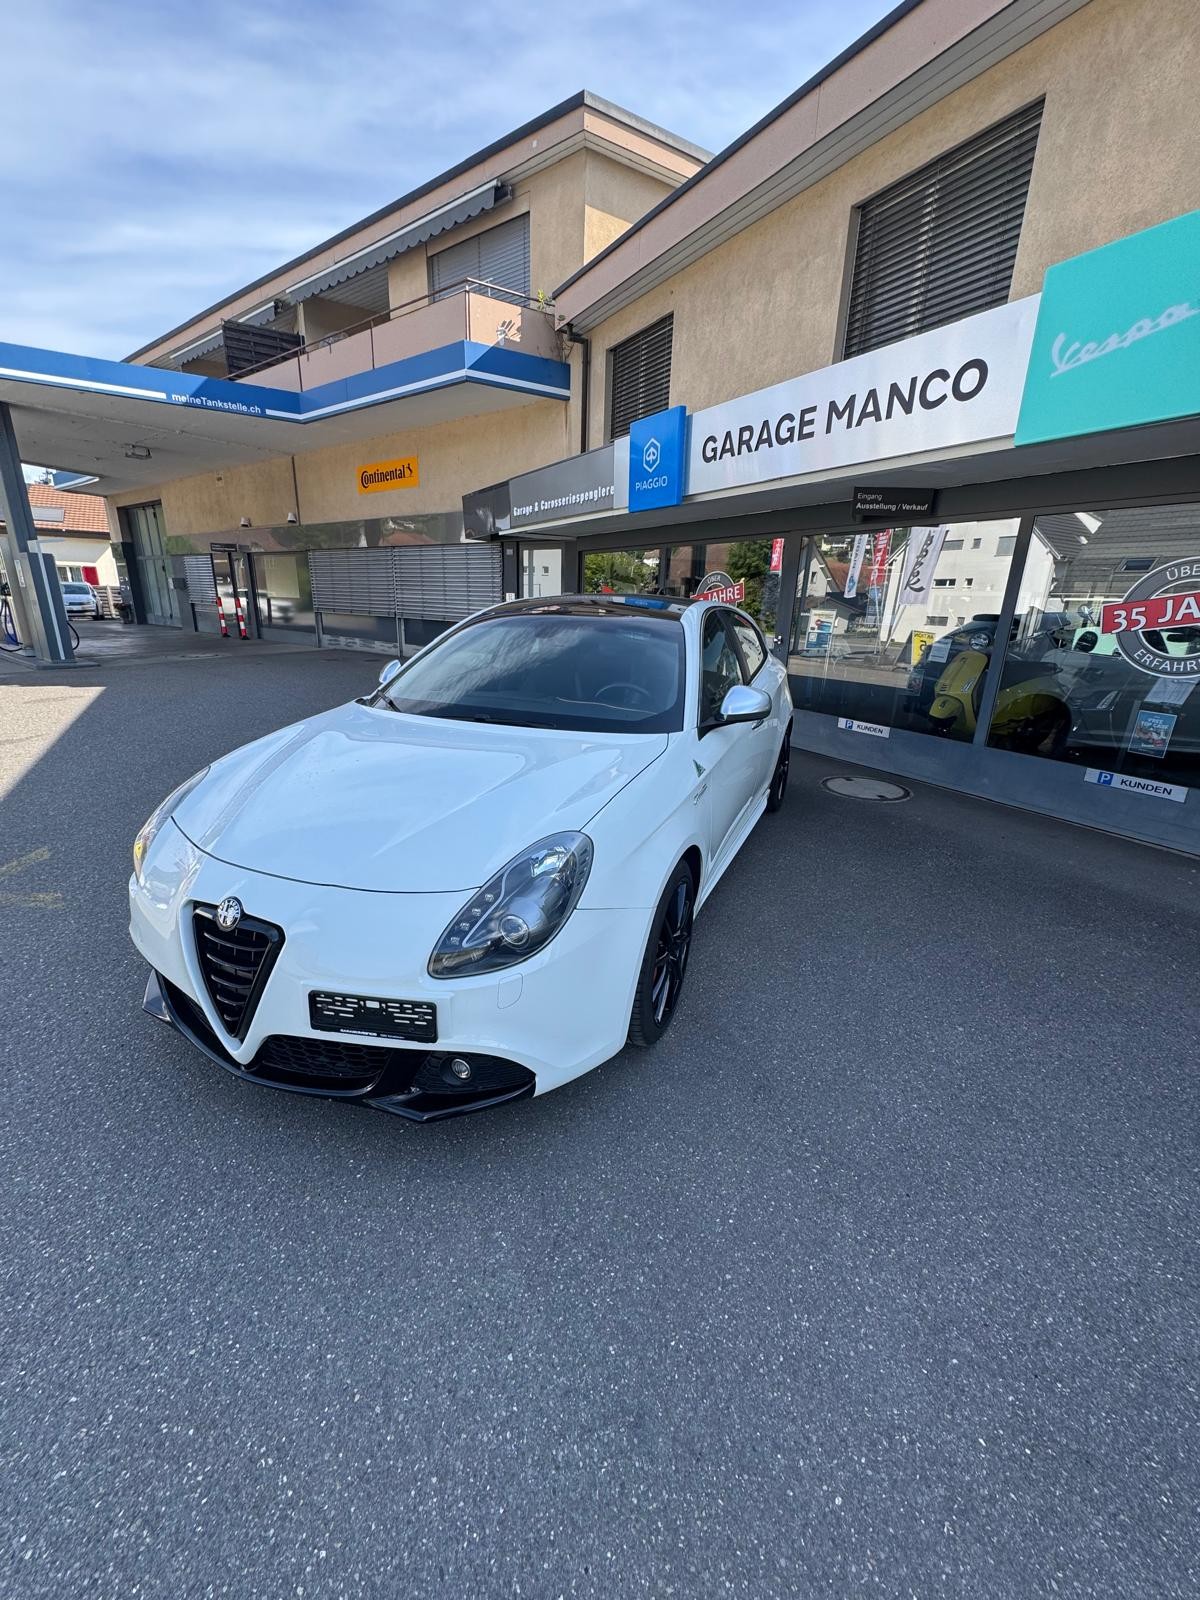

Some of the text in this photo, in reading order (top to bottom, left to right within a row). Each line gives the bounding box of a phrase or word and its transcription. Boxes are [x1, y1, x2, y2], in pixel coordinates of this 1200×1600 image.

[1050, 302, 1200, 377] Vespa
[171, 393, 262, 414] meineTankstelle.ch
[701, 358, 988, 463] GARAGE MANCO
[360, 464, 406, 489] Continental
[635, 475, 668, 491] PIAGGIO
[857, 492, 883, 501] Eingang
[513, 505, 533, 517] Garage
[855, 502, 897, 512] Ausstellung
[902, 503, 929, 511] Verkauf
[1111, 606, 1148, 634] 35
[1133, 648, 1200, 673] ERFAHR
[856, 723, 884, 735] KUNDEN
[1120, 778, 1173, 796] KUNDEN
